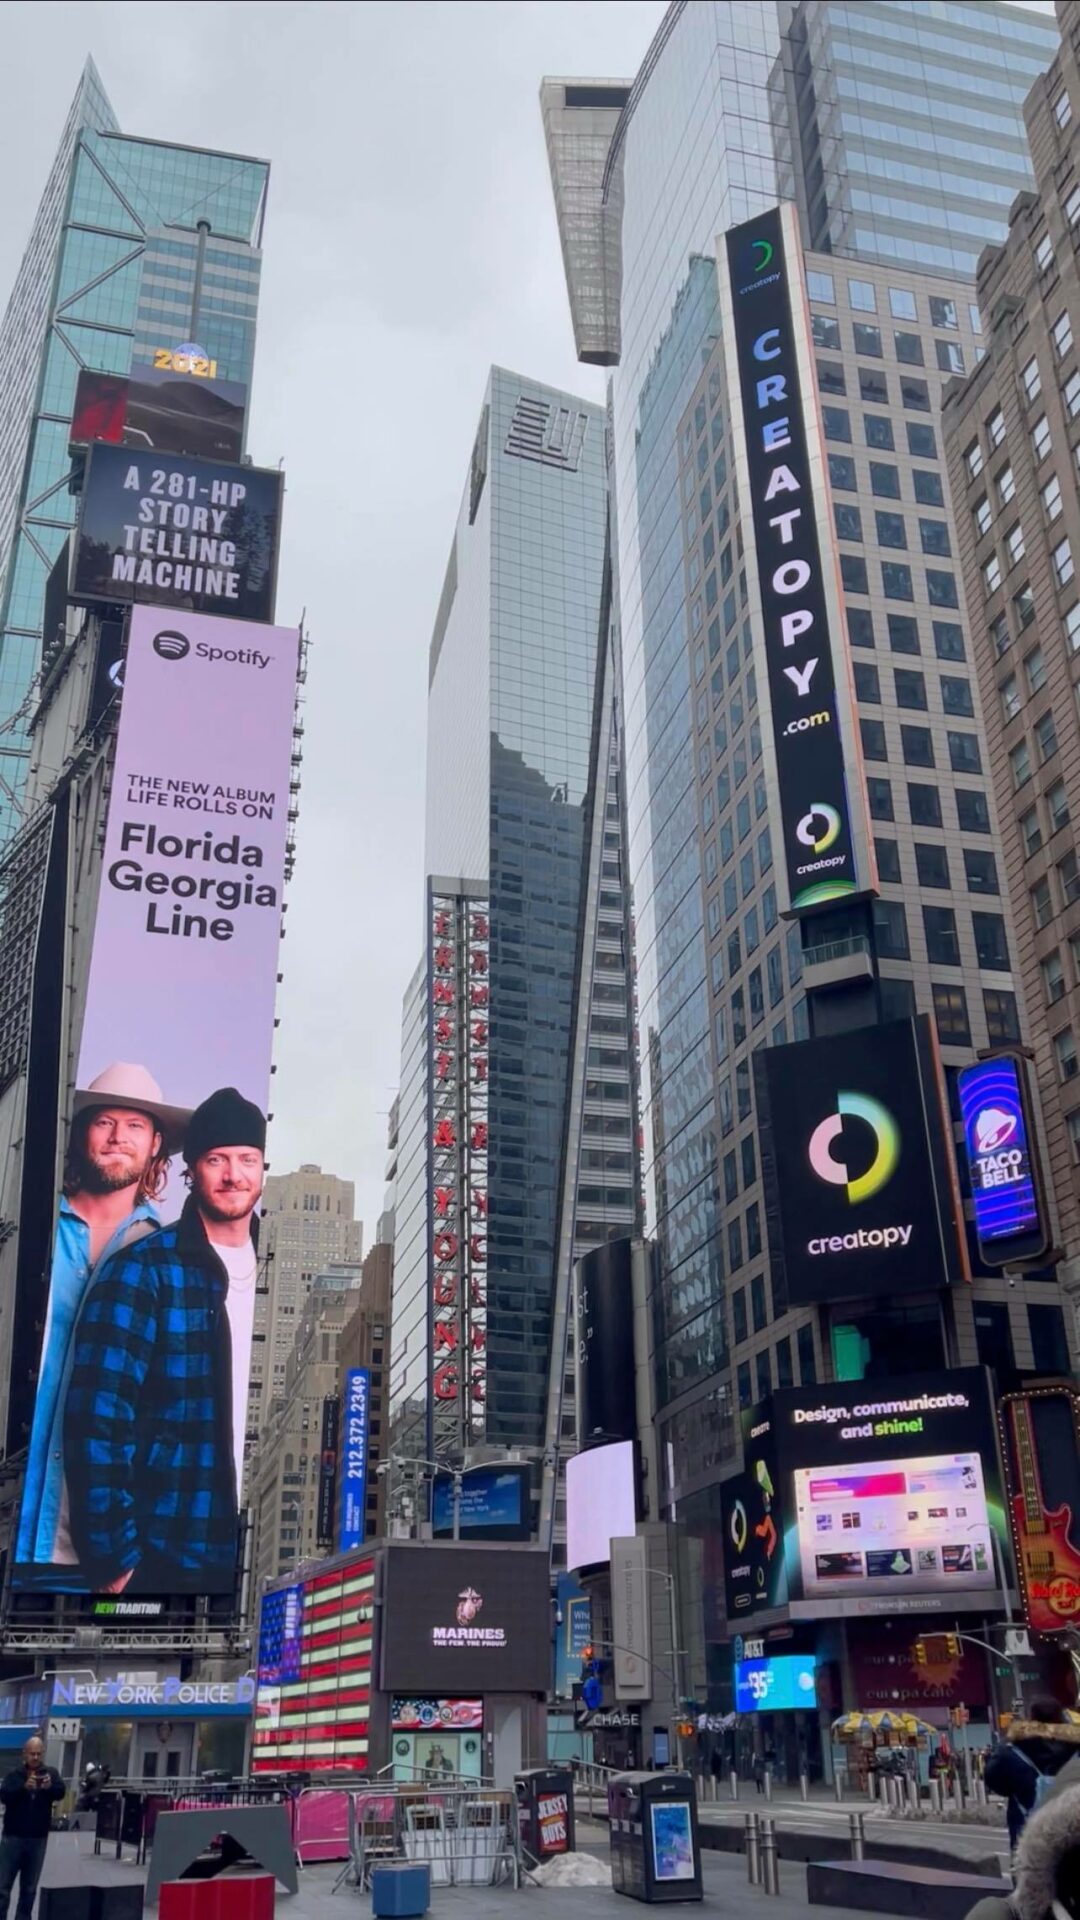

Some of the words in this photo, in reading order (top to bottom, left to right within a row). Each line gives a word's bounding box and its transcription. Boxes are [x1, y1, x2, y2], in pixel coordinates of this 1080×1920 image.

[155, 349, 217, 378] 2021
[124, 466, 140, 491] A
[151, 469, 247, 508] 281-HP
[138, 497, 228, 533] STORY
[753, 328, 819, 697] CREATOPY
[123, 525, 236, 567] TELLING
[111, 554, 241, 599] MACHINE
[195, 642, 271, 669] Spotify
[127, 774, 163, 790] THE
[167, 779, 210, 796] NEW
[212, 785, 276, 805] ALBUM
[127, 788, 168, 807] LIFE
[173, 795, 238, 815] ROLLS
[242, 803, 273, 821] ON
[120, 822, 264, 868] Florida
[796, 854, 847, 876] creatopy
[107, 860, 278, 911] Georgia
[145, 903, 234, 942] Line
[976, 1149, 1022, 1173] TACO
[982, 1165, 1026, 1189] BELL
[807, 1224, 913, 1255] creatopy
[794, 1406, 851, 1423] Design,
[853, 1394, 970, 1417] communicate,
[348, 1376, 367, 1478] 212.372.2349
[840, 1423, 873, 1439] and
[874, 1418, 924, 1437] shine!
[433, 1627, 505, 1640] MARINES
[53, 1677, 103, 1704] NEW
[106, 1677, 158, 1704] YORK
[162, 1677, 230, 1704] POLICE
[593, 1714, 640, 1726] CHASE
